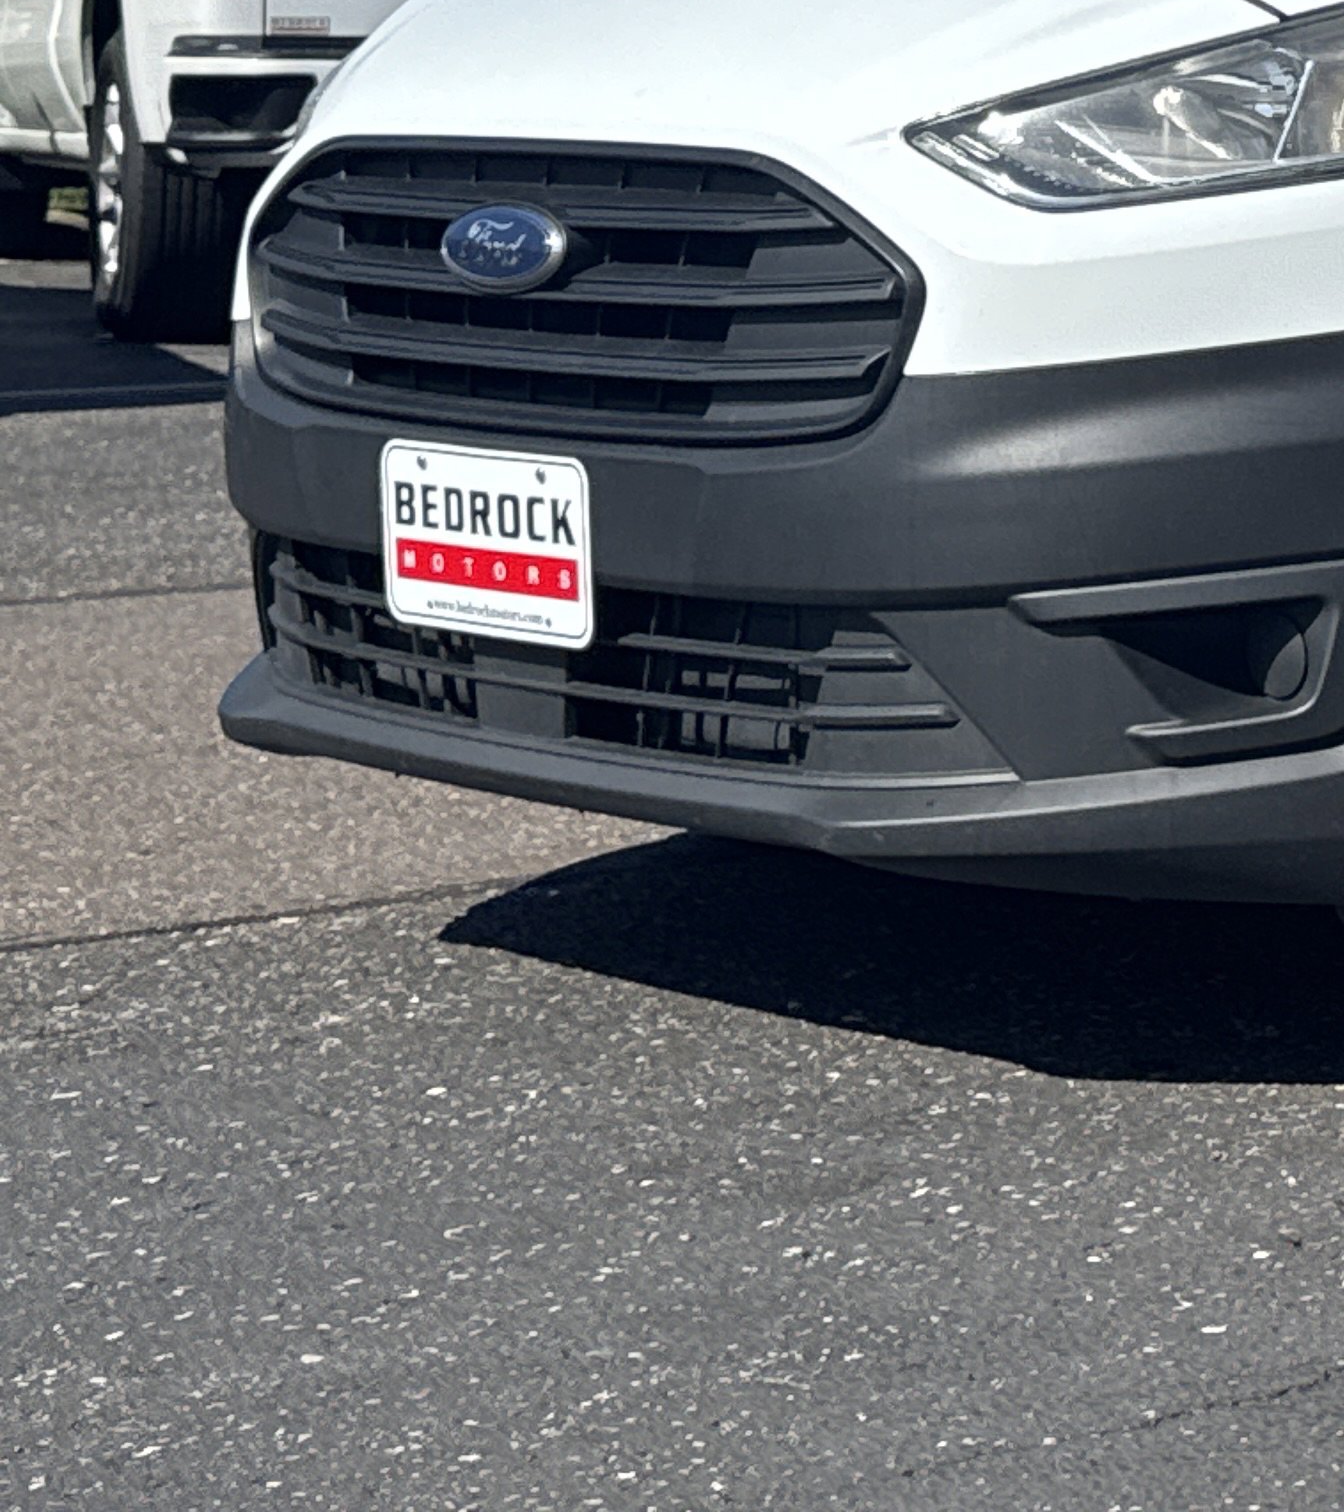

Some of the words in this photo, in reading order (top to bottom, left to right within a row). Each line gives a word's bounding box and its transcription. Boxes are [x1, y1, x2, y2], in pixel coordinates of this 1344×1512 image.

[462, 218, 528, 262] Ford
[394, 481, 576, 546] BEDROCK
[403, 549, 572, 590] MOTORS
